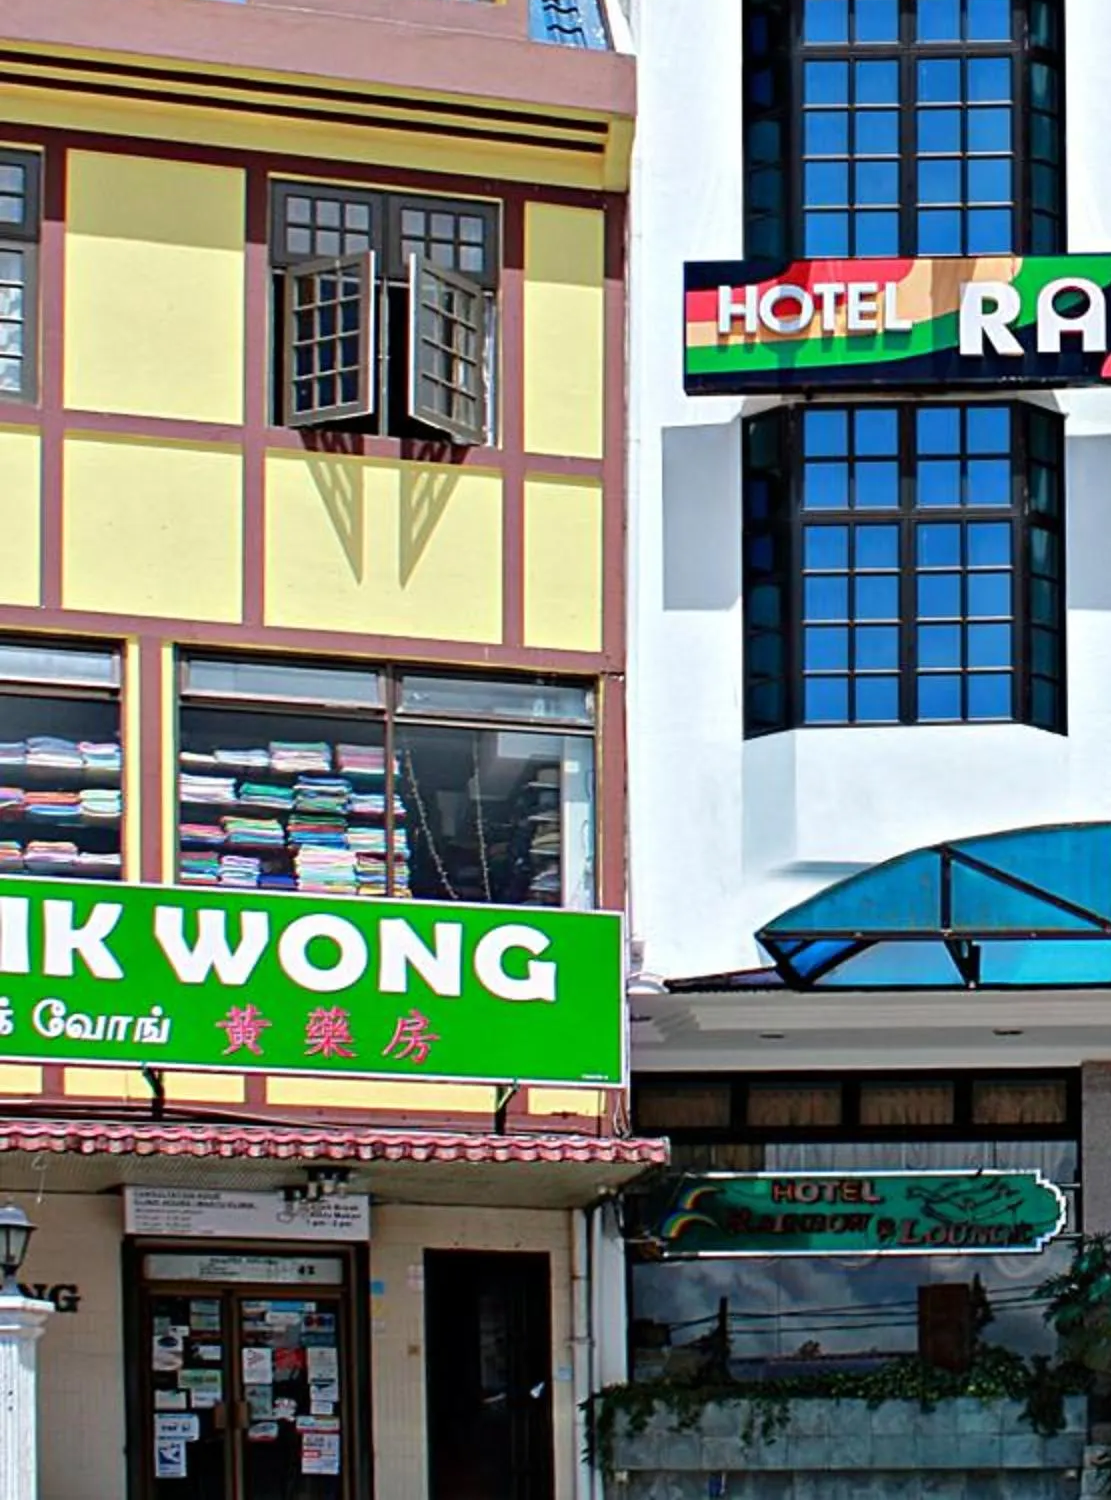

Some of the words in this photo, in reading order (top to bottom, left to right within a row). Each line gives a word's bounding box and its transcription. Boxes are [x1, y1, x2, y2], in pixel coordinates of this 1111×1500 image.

[716, 281, 913, 335] HOTEL
[153, 904, 558, 1002] WONG
[770, 1179, 883, 1205] HOTEL
